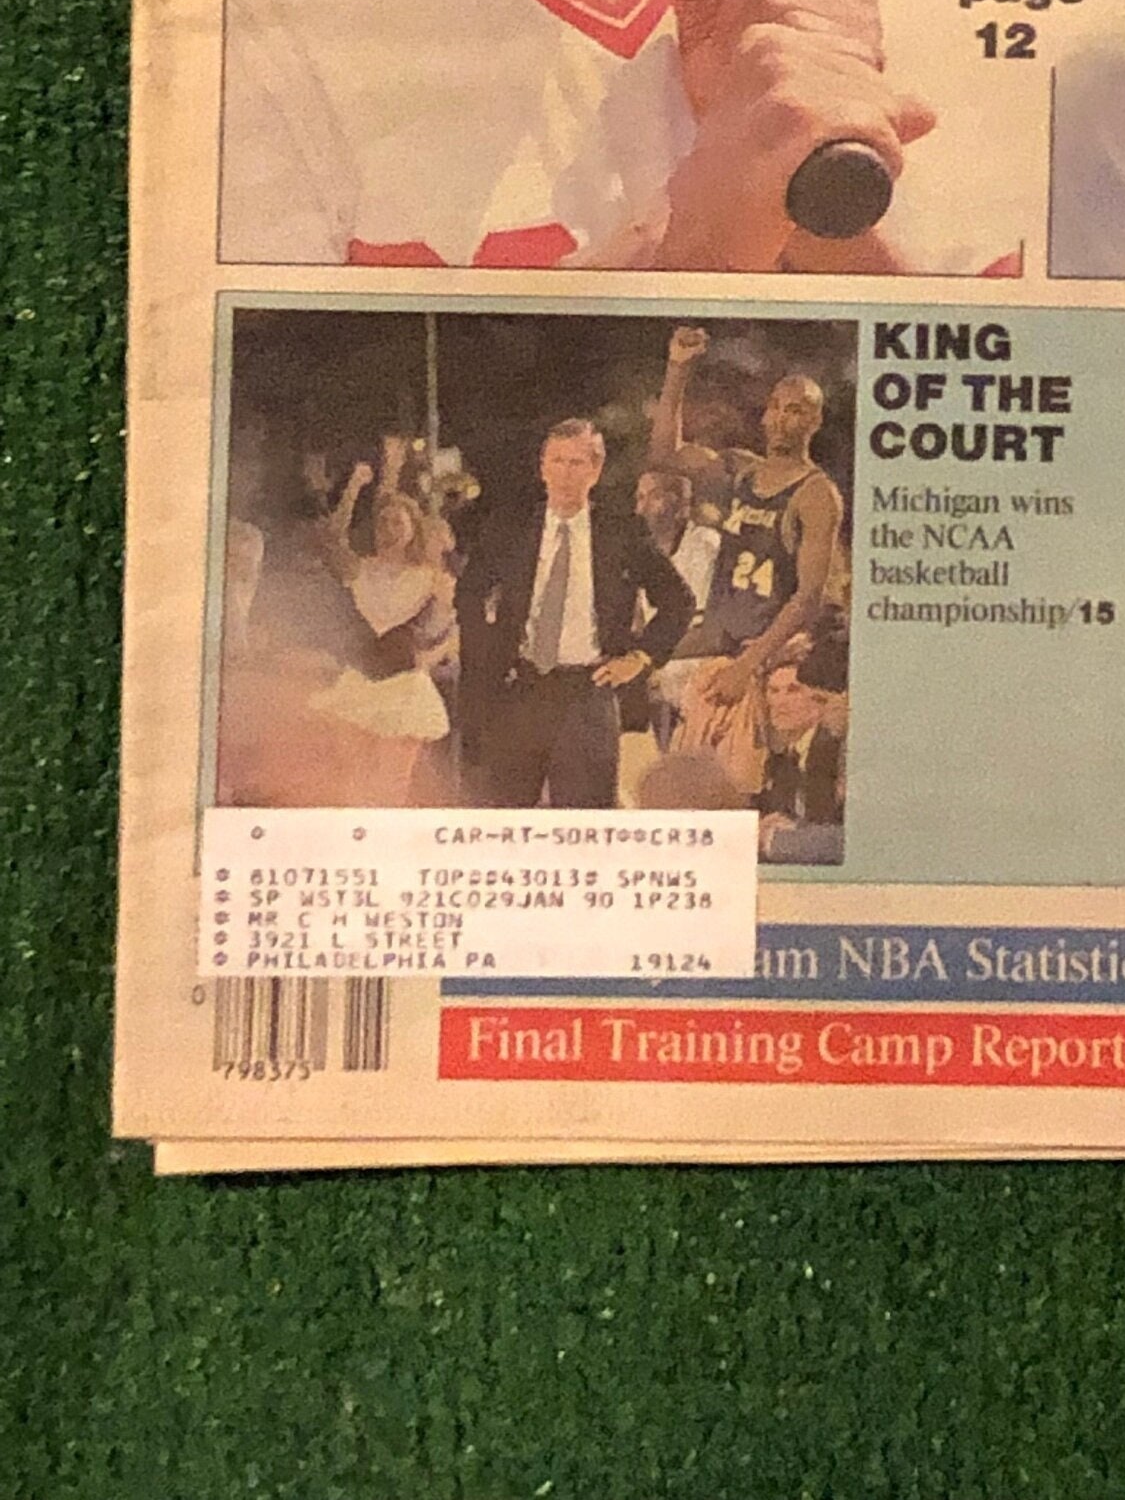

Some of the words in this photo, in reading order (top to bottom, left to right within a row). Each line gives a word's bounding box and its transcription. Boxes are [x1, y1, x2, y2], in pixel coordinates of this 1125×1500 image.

[975, 23, 1036, 60] 12
[874, 322, 1011, 361] KING
[873, 372, 947, 411] OF
[961, 374, 1072, 413] THE
[869, 421, 1065, 462] COURT
[872, 486, 1000, 518] Michigan
[1011, 489, 1075, 516] wins
[870, 523, 914, 549] the
[922, 524, 1014, 551] NCAA
[869, 559, 1009, 587] basketball
[249, 931, 309, 949] 3921
[331, 932, 345, 948] L
[365, 931, 463, 949] STREET
[838, 936, 949, 981] NBA
[247, 951, 447, 970] PHILADELPHIA
[465, 952, 497, 969] PA
[630, 953, 712, 971] 19124
[469, 1015, 584, 1062] Final
[602, 1018, 804, 1075] Training
[818, 1021, 953, 1076] Camp
